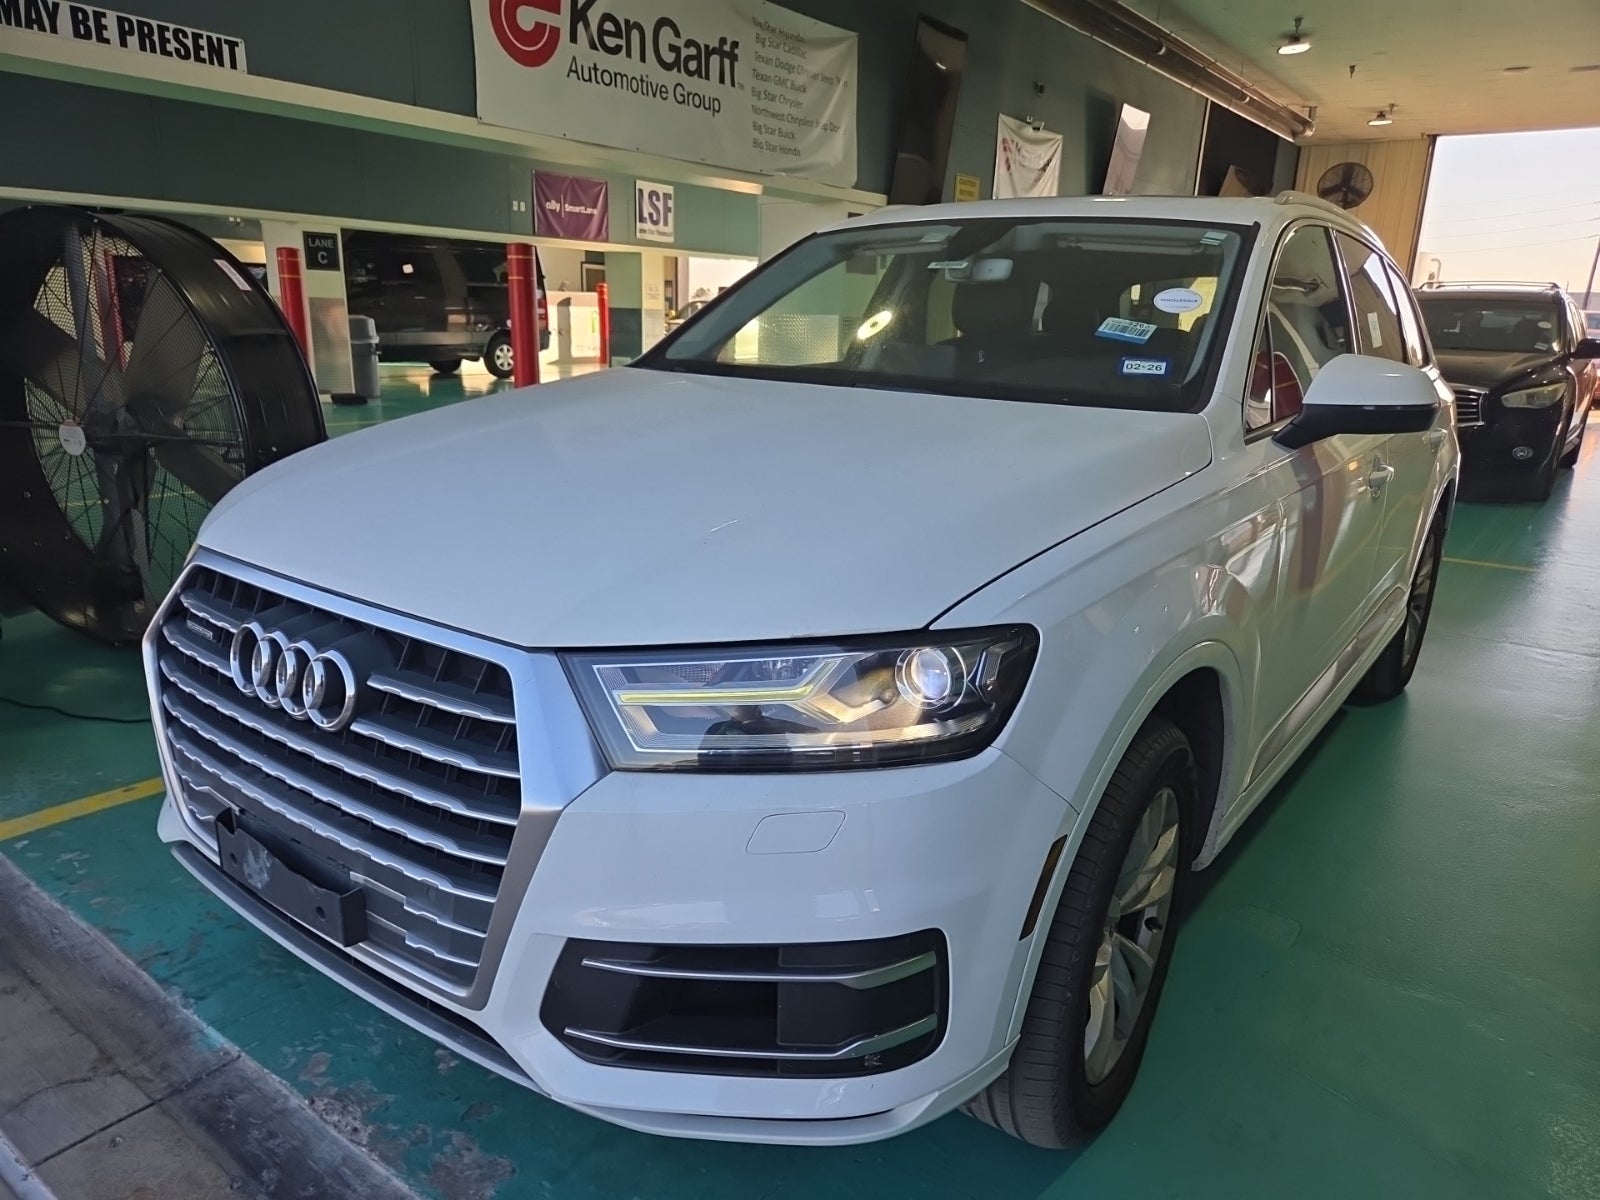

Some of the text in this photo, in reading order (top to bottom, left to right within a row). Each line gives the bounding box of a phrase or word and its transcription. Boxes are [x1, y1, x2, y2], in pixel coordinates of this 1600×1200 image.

[0, 0, 239, 70] MAY BE PRESENT
[755, 32, 767, 49] Big
[768, 36, 782, 50] Star
[569, 0, 647, 63] Ken
[652, 16, 740, 88] Garff
[754, 51, 774, 67] Texan
[752, 68, 772, 84] Texan
[567, 56, 722, 117] Automotive Group
[763, 89, 778, 103] Star
[763, 123, 778, 136] Star
[764, 141, 778, 153] Star
[638, 188, 672, 227] LSF
[308, 238, 335, 249] LANE
[317, 251, 328, 265] C
